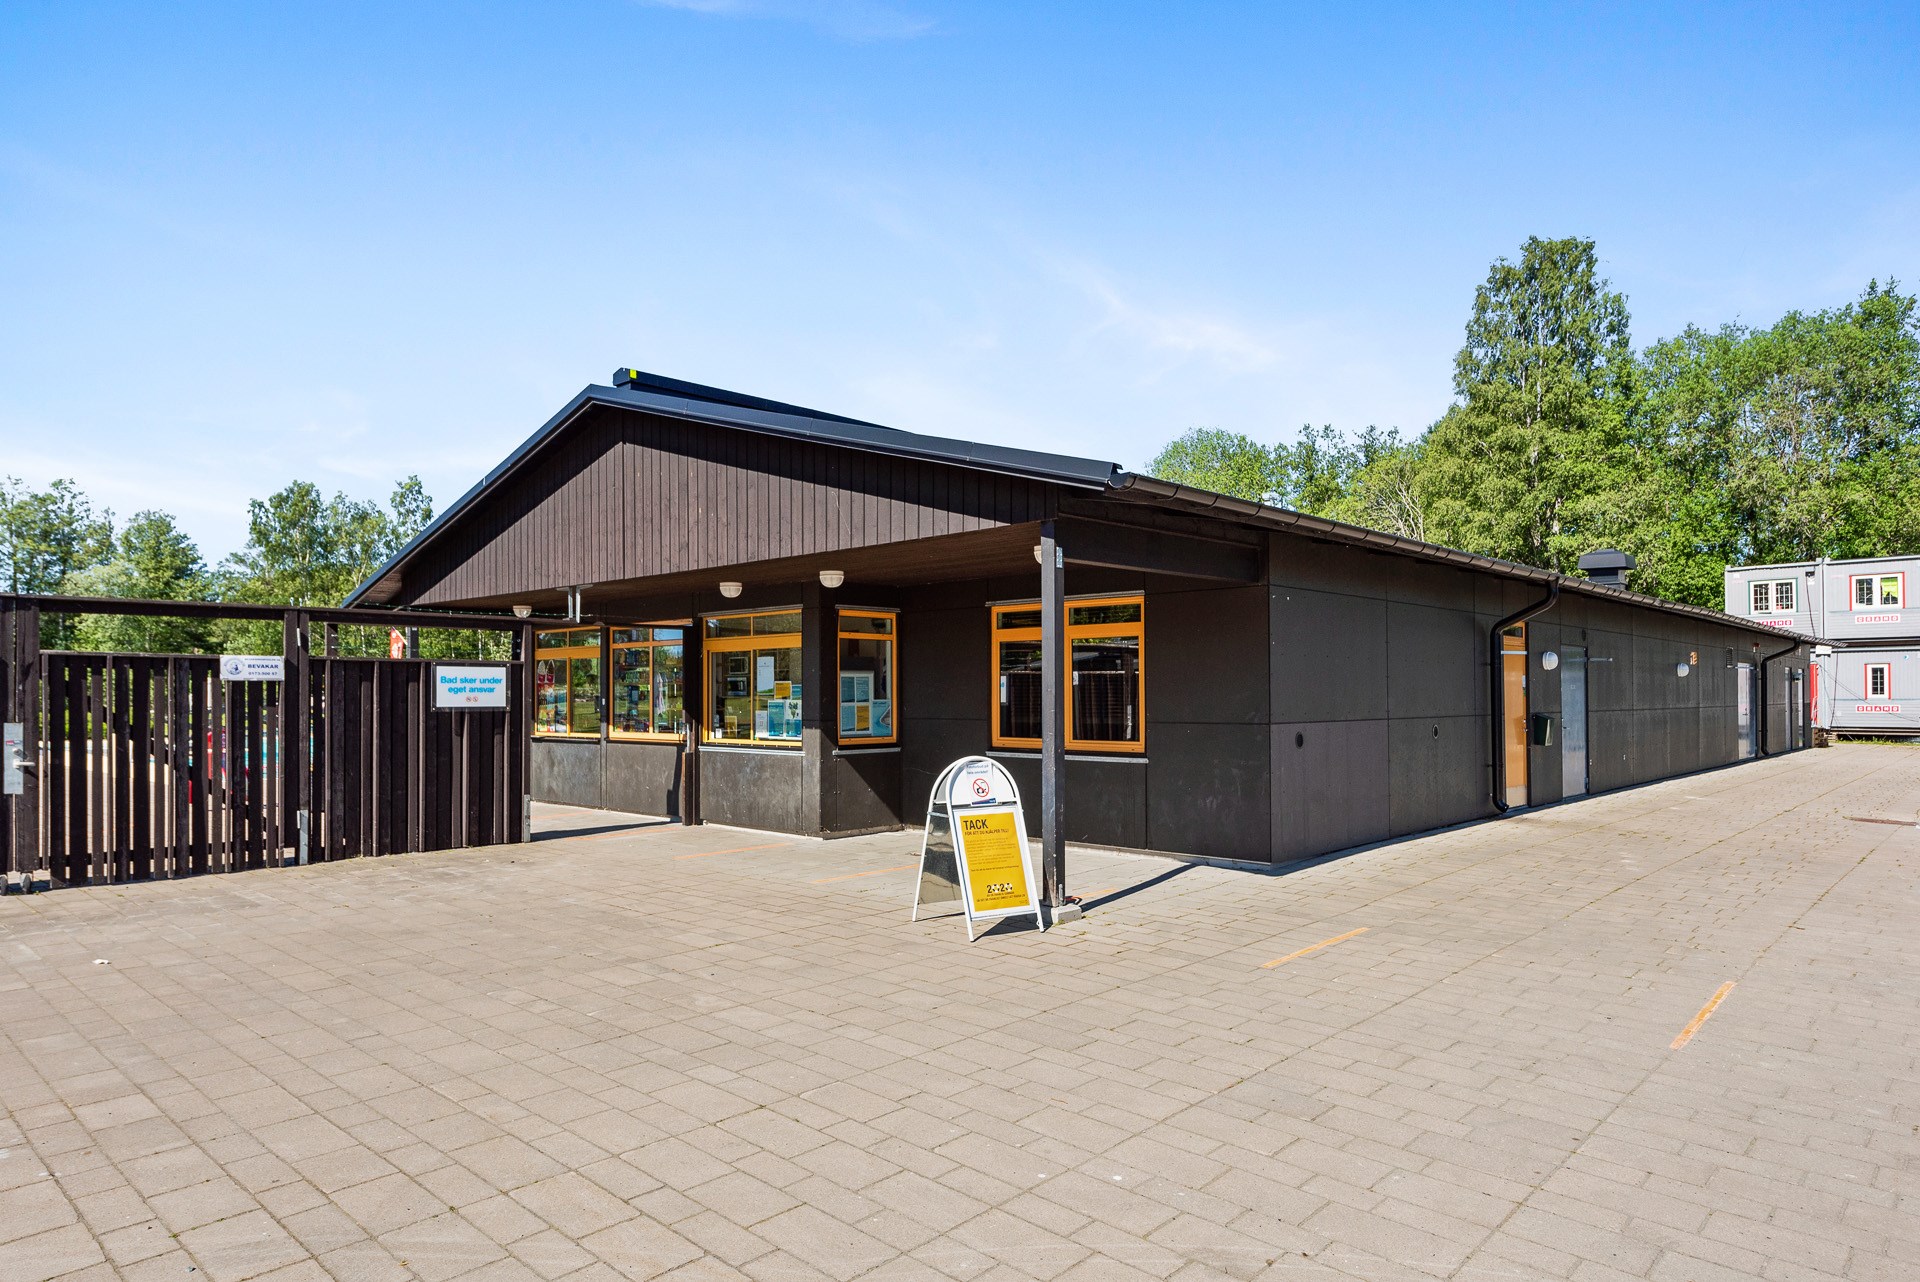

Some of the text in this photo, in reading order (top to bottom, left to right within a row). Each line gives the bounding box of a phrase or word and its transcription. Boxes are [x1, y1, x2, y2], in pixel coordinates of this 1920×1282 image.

[440, 675, 503, 684] Bad sker under
[448, 686, 467, 695] eget
[963, 819, 989, 831] TACK
